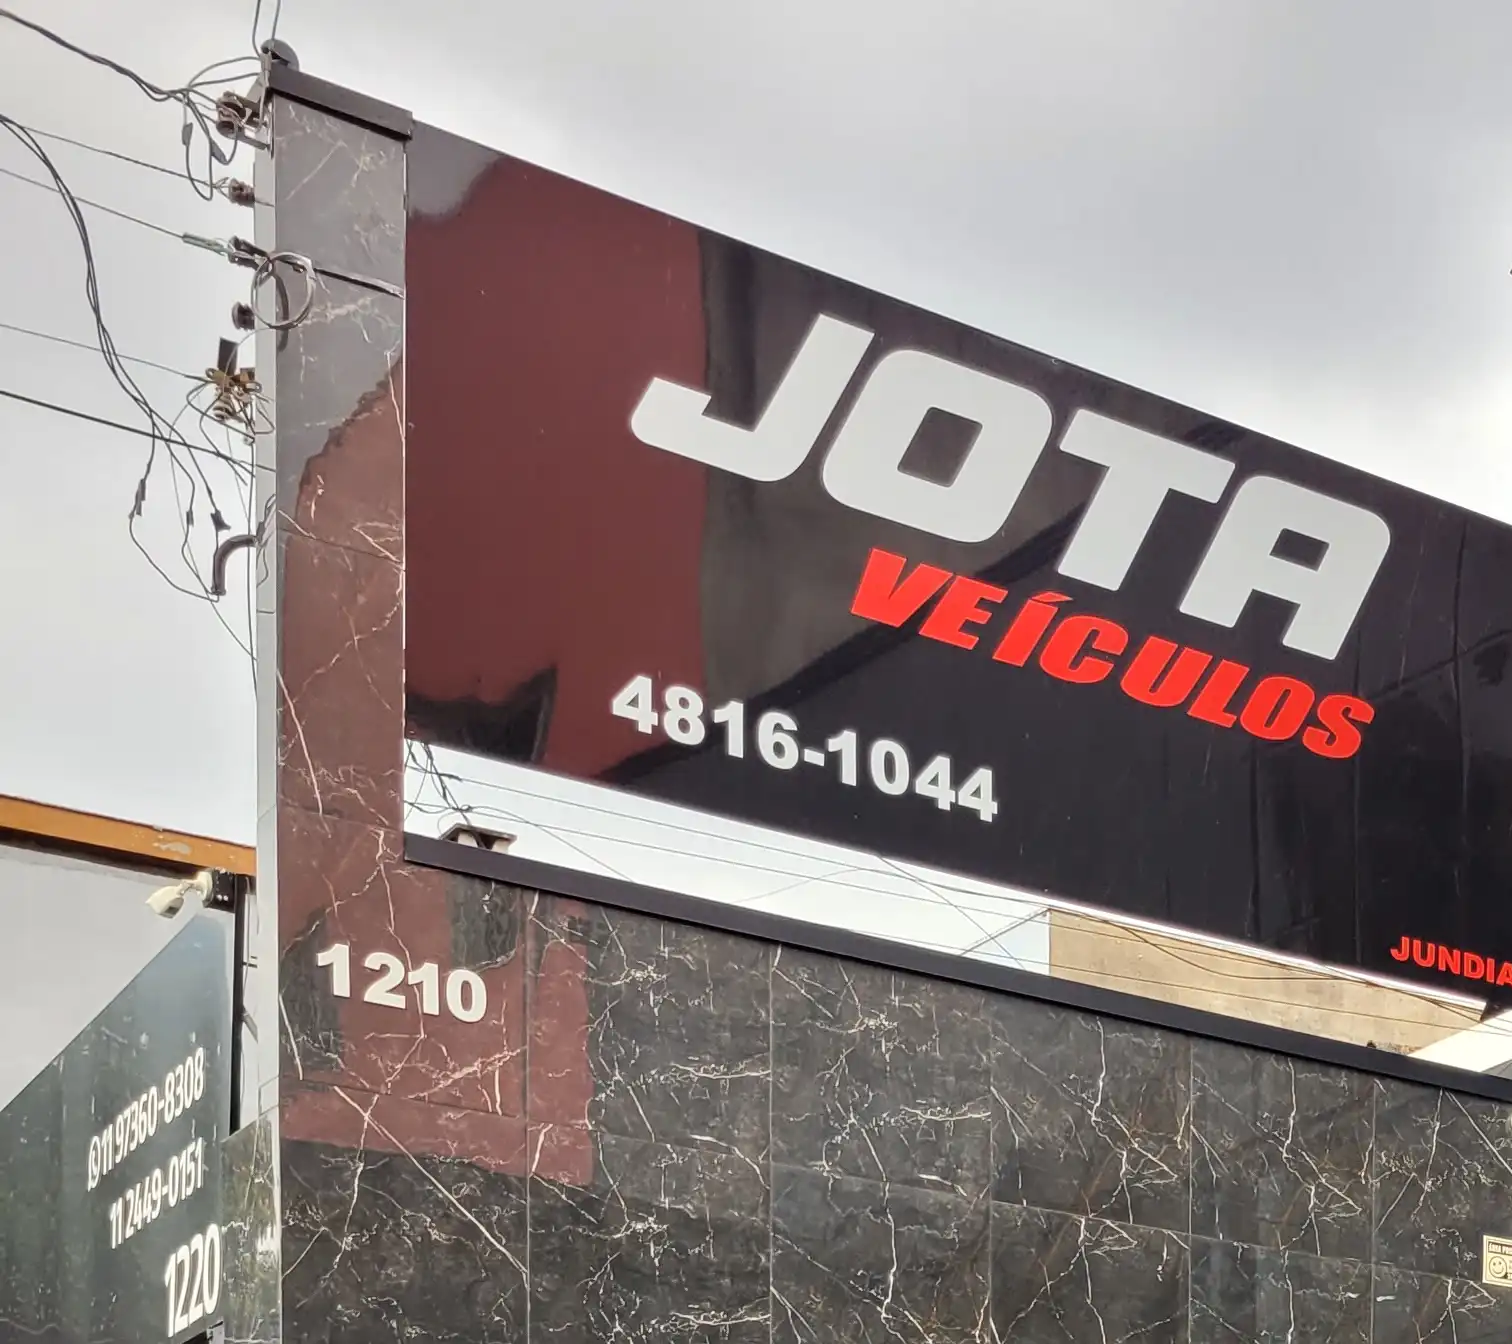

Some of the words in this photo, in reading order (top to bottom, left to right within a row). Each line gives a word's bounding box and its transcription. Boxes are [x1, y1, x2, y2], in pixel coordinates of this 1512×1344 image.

[630, 313, 1392, 661] JOTA
[850, 547, 1376, 760] VEÍCULOS
[611, 674, 999, 823] 4816-1044
[316, 942, 488, 1023] 1210
[114, 1046, 207, 1165] 97360-8308
[123, 1136, 206, 1241] 2449-0151
[164, 1221, 222, 1339] 1220
